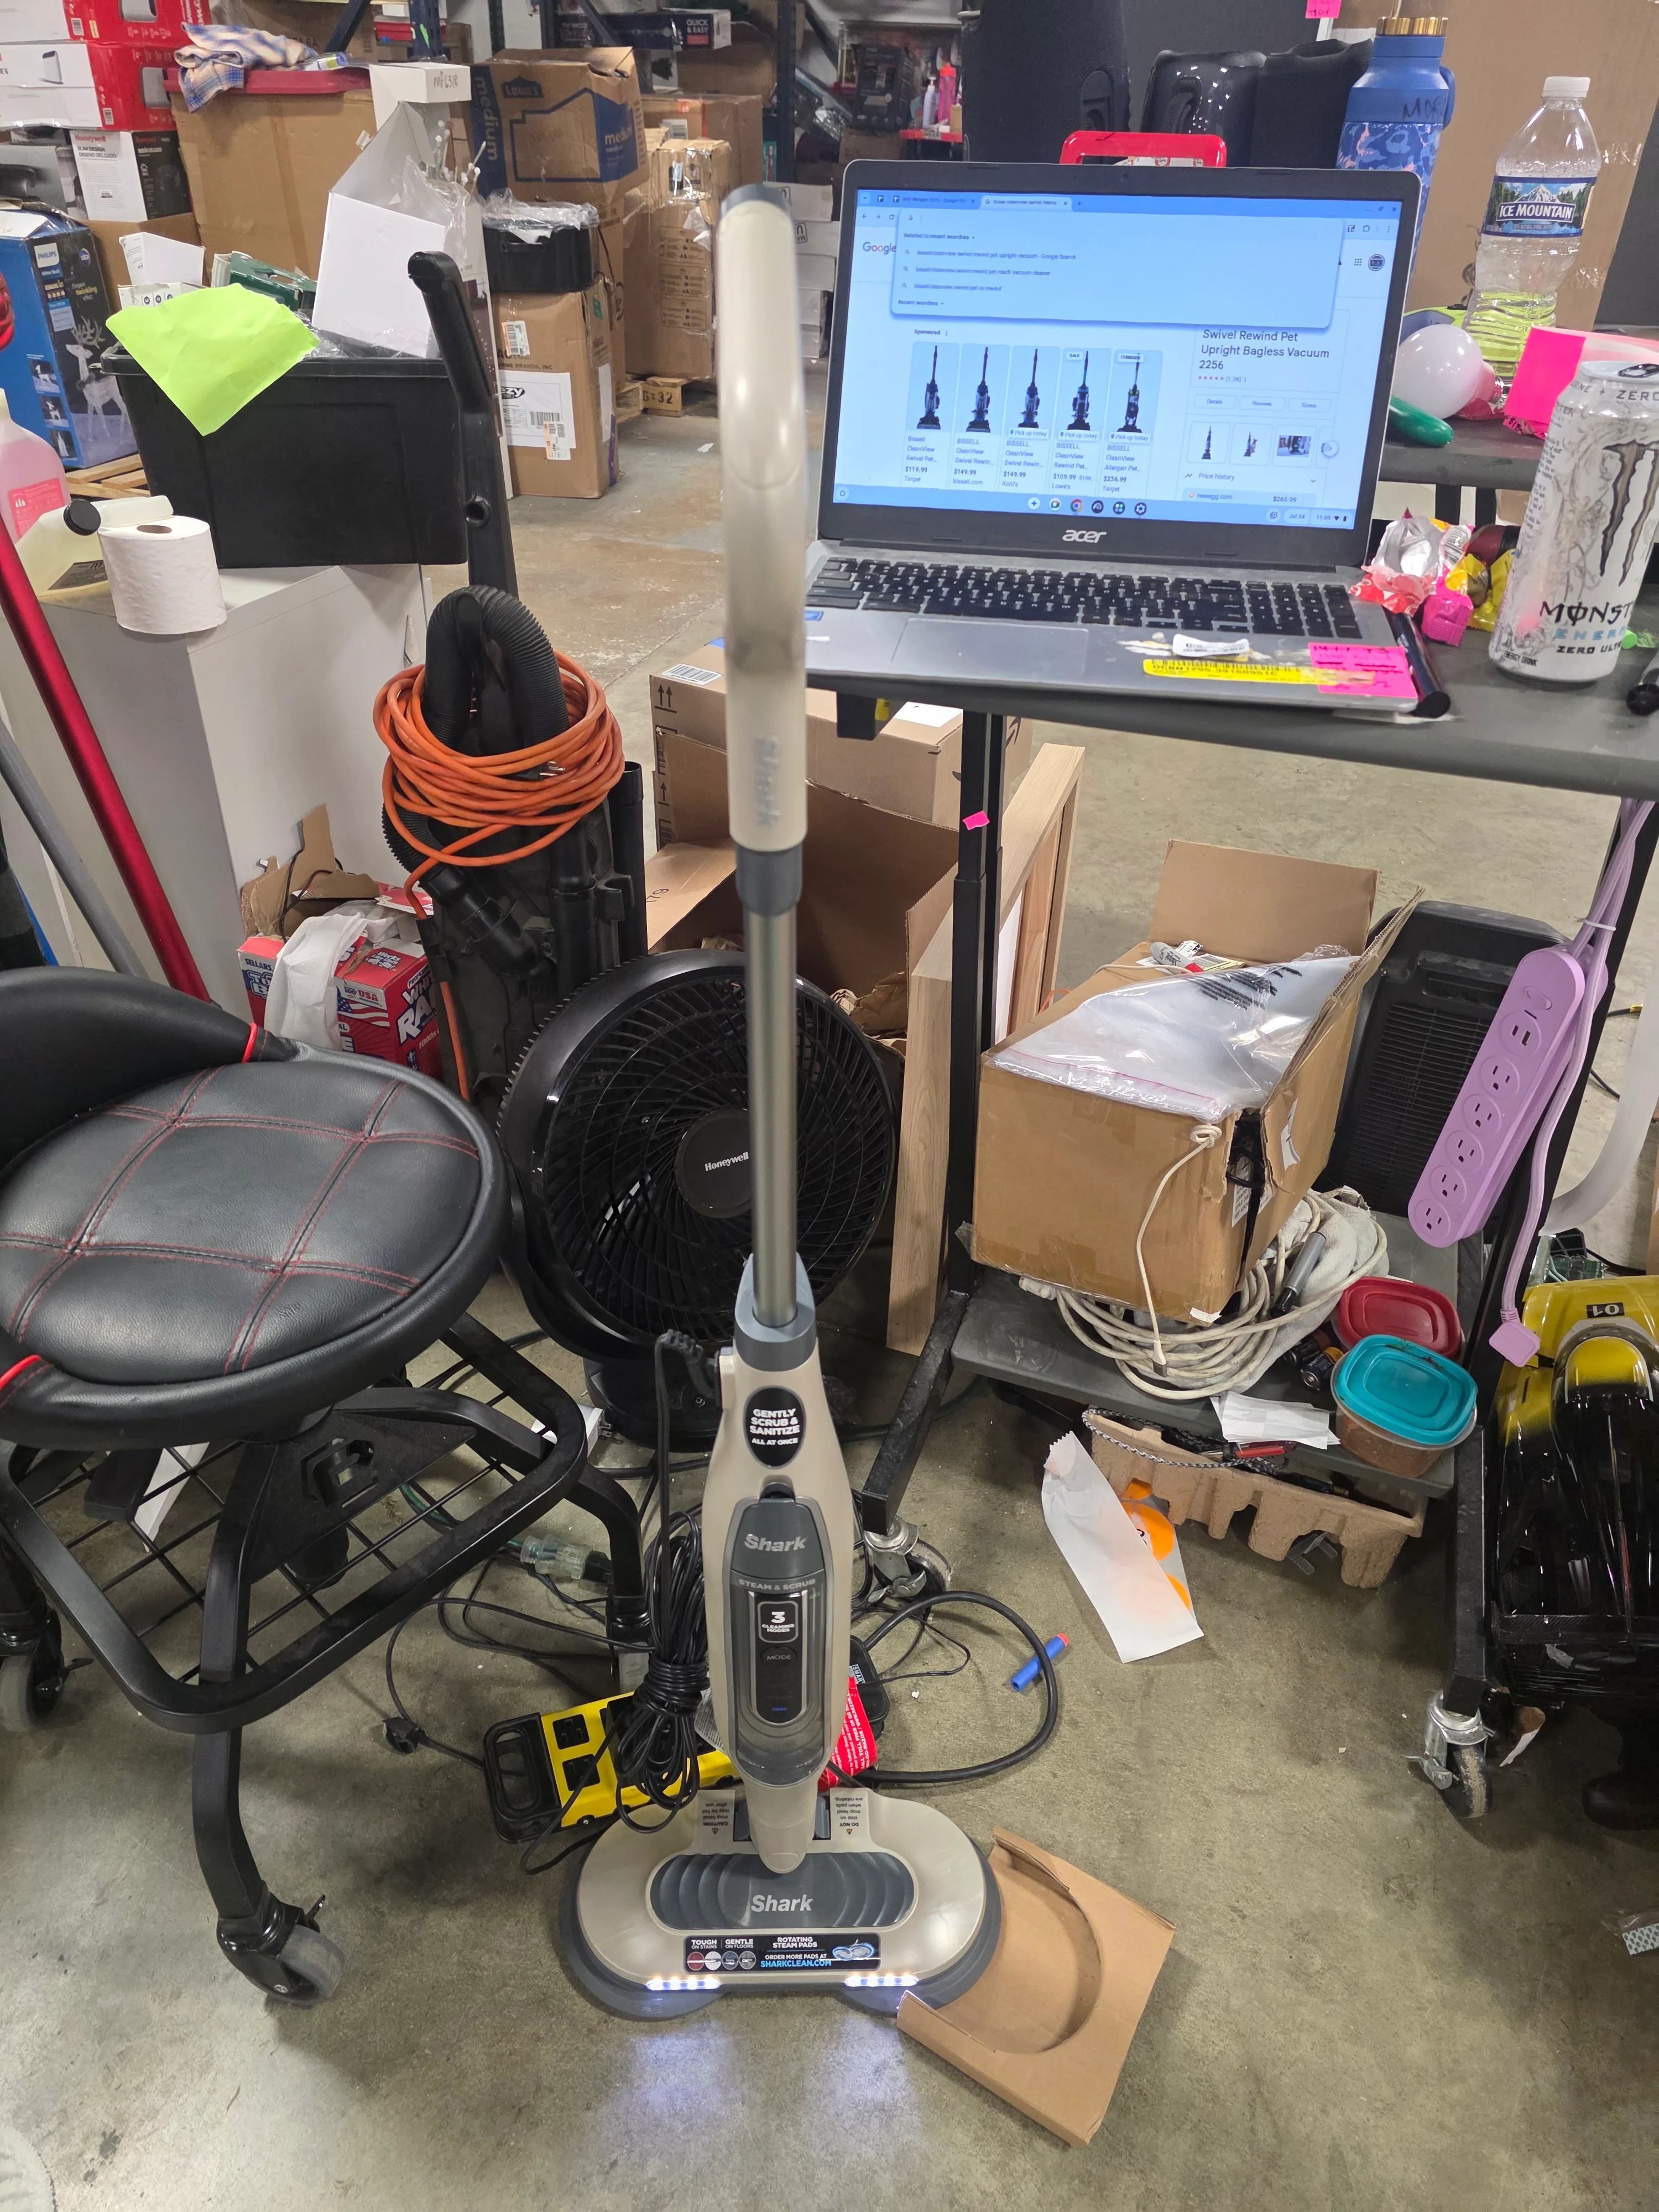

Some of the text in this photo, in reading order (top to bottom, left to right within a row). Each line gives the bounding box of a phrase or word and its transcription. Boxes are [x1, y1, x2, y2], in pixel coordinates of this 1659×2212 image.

[474, 76, 497, 161] medium
[1500, 204, 1574, 220] ICE MOUNTAIN
[863, 242, 896, 254] Google
[38, 251, 57, 260] PHILIPS
[1203, 329, 1298, 342] Swivel Rewind Pet
[1201, 345, 1330, 358] Upright Bagless Vacuum
[1198, 359, 1224, 369] 2256
[1032, 430, 1047, 439] today
[1104, 464, 1127, 472] Allergen
[1214, 473, 1235, 482] history
[1062, 529, 1107, 544] acer
[1556, 645, 1595, 654] ZERO
[1504, 650, 1538, 667] ENERGY DRINK
[377, 951, 401, 962] Works
[358, 989, 380, 1002] USA
[705, 1151, 749, 1172] Honeywell
[753, 1408, 796, 1418] GENTLY
[751, 1417, 799, 1427] SCRUB &
[749, 1425, 800, 1435] SANITIZE
[744, 1533, 806, 1552] Shark
[739, 1579, 771, 1591] STEAM
[783, 1578, 816, 1590] SCRUB
[771, 1611, 786, 1624] 3
[852, 1665, 865, 1684] SMAR
[751, 1894, 813, 1912] Shark
[760, 1959, 832, 1968] SHARKCLEAN.COM
